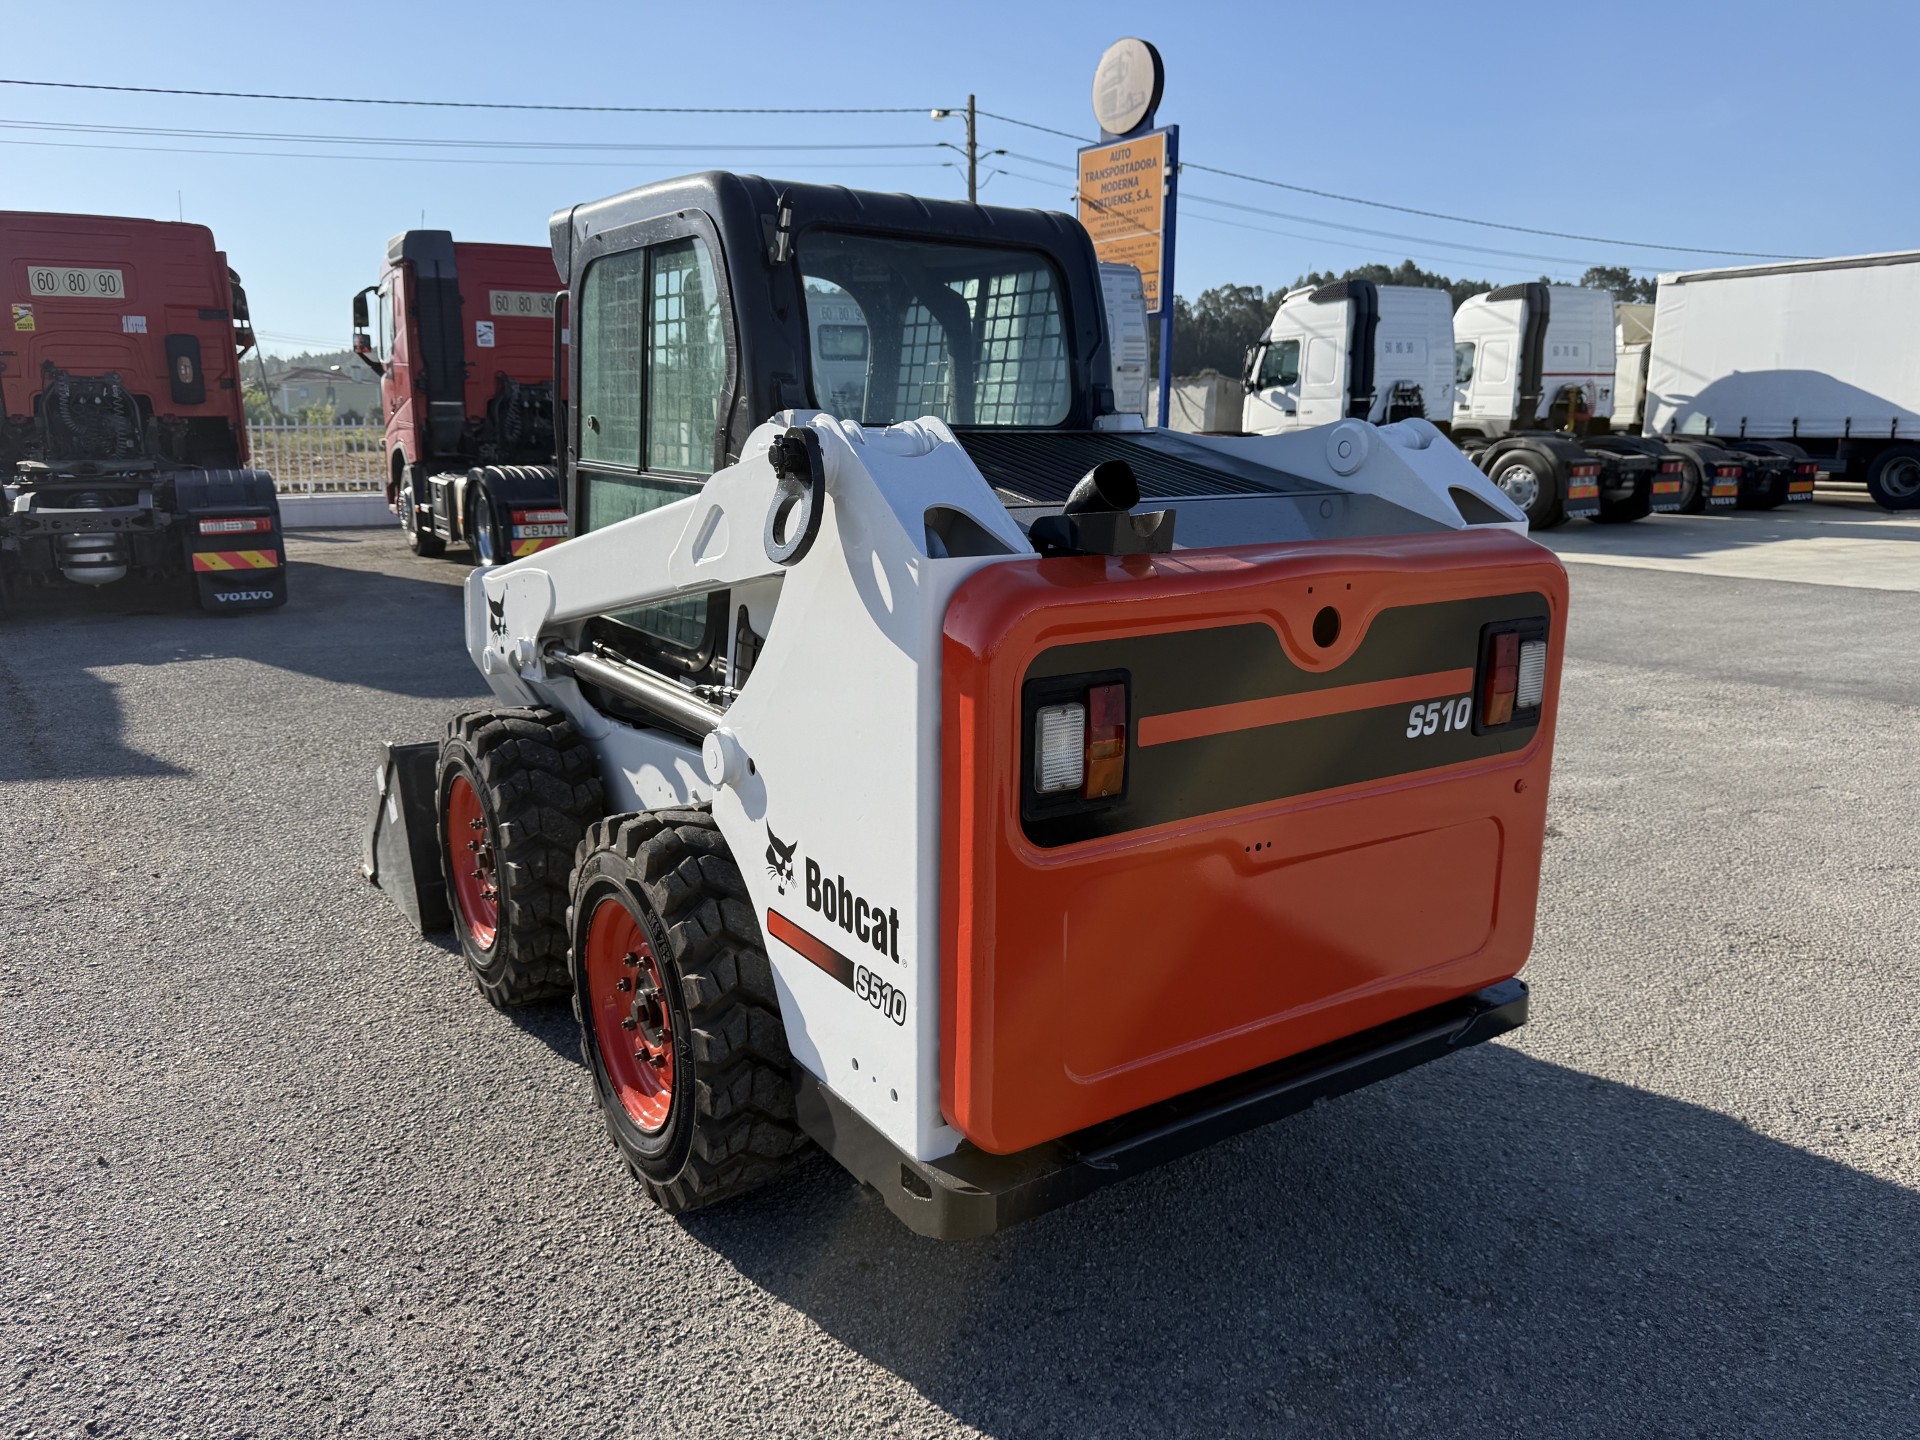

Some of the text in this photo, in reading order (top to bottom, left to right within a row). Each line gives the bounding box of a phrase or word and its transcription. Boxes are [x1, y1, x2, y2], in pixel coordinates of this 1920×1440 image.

[1109, 147, 1131, 162] AUTO
[1085, 157, 1158, 183] TRANSPORTADORA
[1101, 176, 1139, 195] MODERNA
[1137, 188, 1152, 201] S.A.
[37, 272, 116, 293] 60 80 90
[495, 295, 554, 313] 60 80 90
[1710, 497, 1737, 505] VOLVO
[1567, 508, 1600, 518] VOLVO
[523, 525, 539, 536] CB
[540, 524, 553, 535] 47
[213, 590, 273, 602] VOLVO
[1406, 697, 1472, 739] S510
[805, 856, 900, 964] Bobcat
[856, 964, 907, 1027] S510
